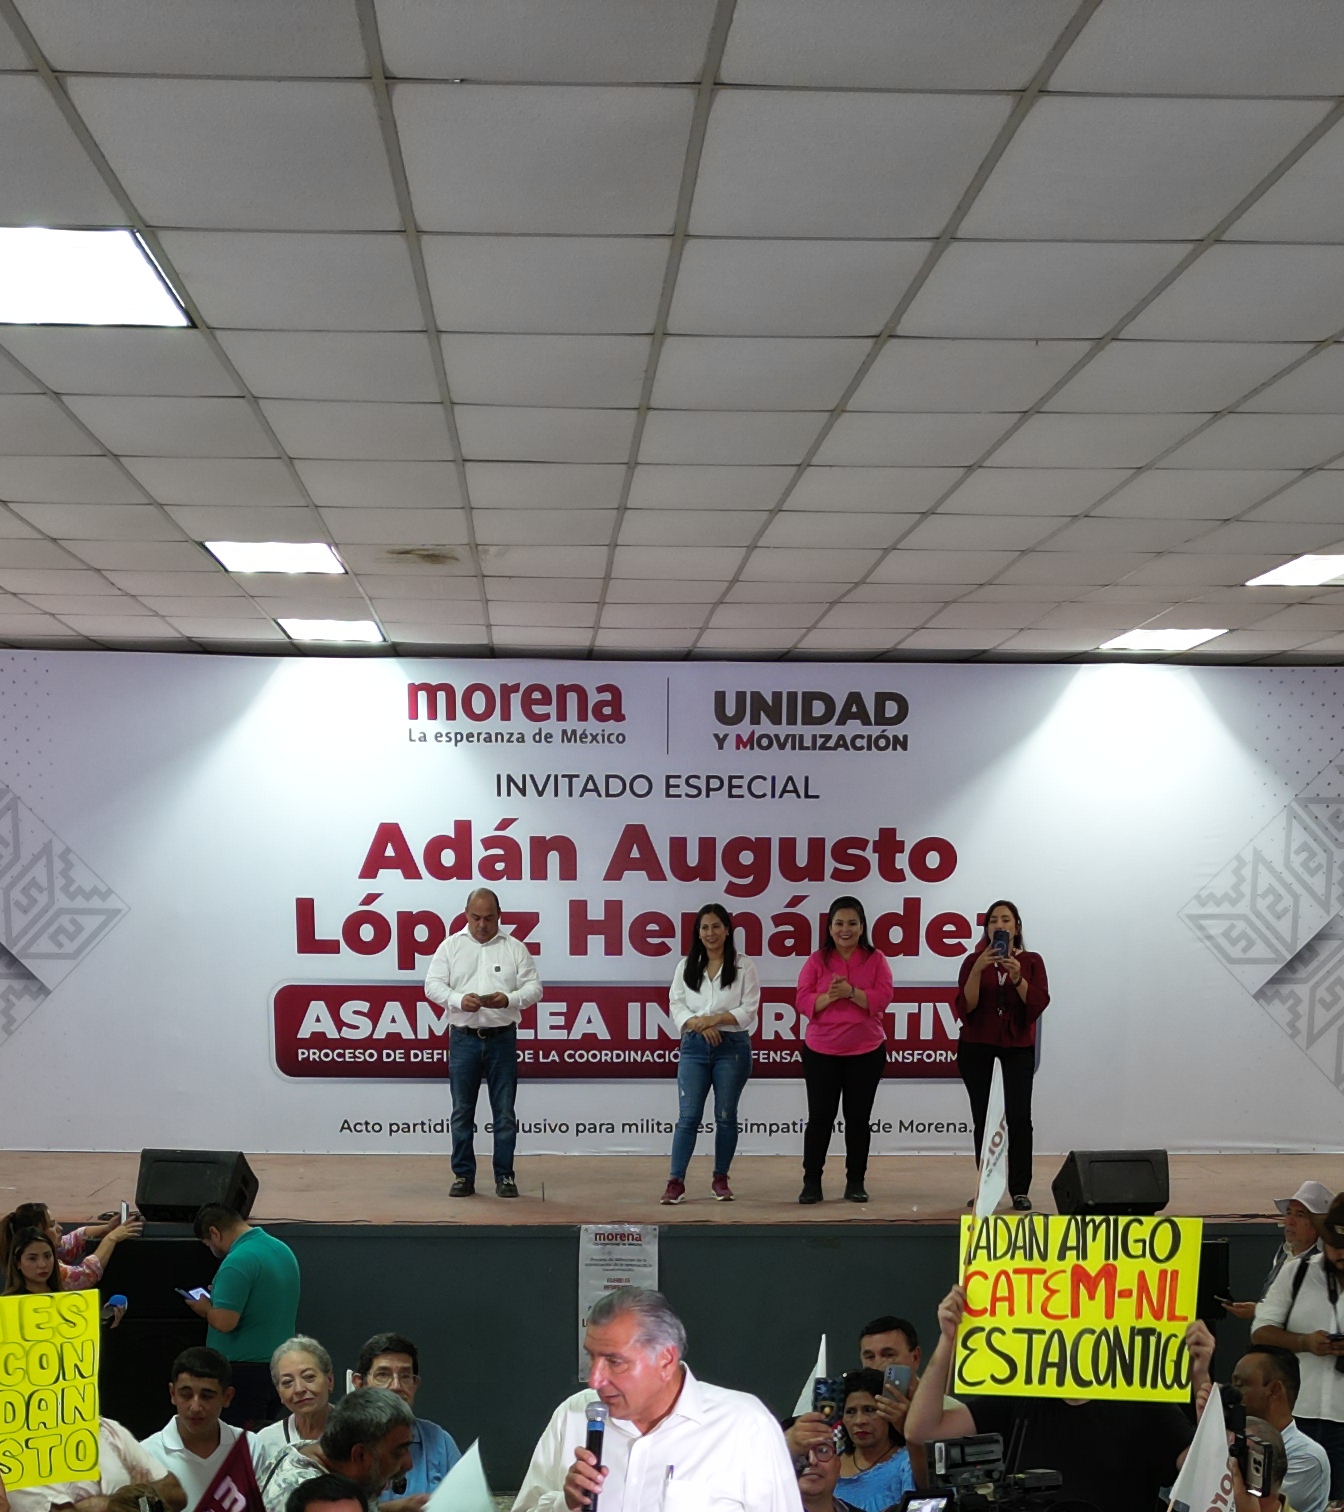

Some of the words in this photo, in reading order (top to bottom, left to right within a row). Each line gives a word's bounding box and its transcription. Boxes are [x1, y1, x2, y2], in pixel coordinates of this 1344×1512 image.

[407, 681, 626, 723] morena
[714, 690, 909, 727] UNIDAD
[409, 728, 428, 743] La
[434, 729, 526, 747] esperanza
[532, 727, 553, 744] de
[560, 726, 626, 744] México
[713, 733, 729, 750] Y
[735, 729, 909, 752] MOVILIZACIÓN
[495, 773, 654, 799] INVITADO
[663, 774, 820, 800] ESPECIAL
[357, 817, 578, 881] Adán
[602, 823, 958, 898] Augusto
[297, 1000, 611, 1040] ASAMLEA
[297, 1048, 378, 1063] PROCESO
[382, 1049, 406, 1063] DE
[539, 1049, 560, 1064] LA
[564, 1046, 682, 1064] COORDINACIÓ
[339, 1118, 383, 1134] Acto
[484, 1117, 570, 1135] elusivo
[575, 1122, 615, 1138] para
[621, 1117, 714, 1135] militaes
[871, 1117, 893, 1135] de
[899, 1118, 974, 1135] Morena.
[594, 1231, 642, 1242] morena
[1057, 1215, 1182, 1263] AMIGO
[963, 1263, 1189, 1322] CATEM-NL
[19, 1293, 90, 1341] ES
